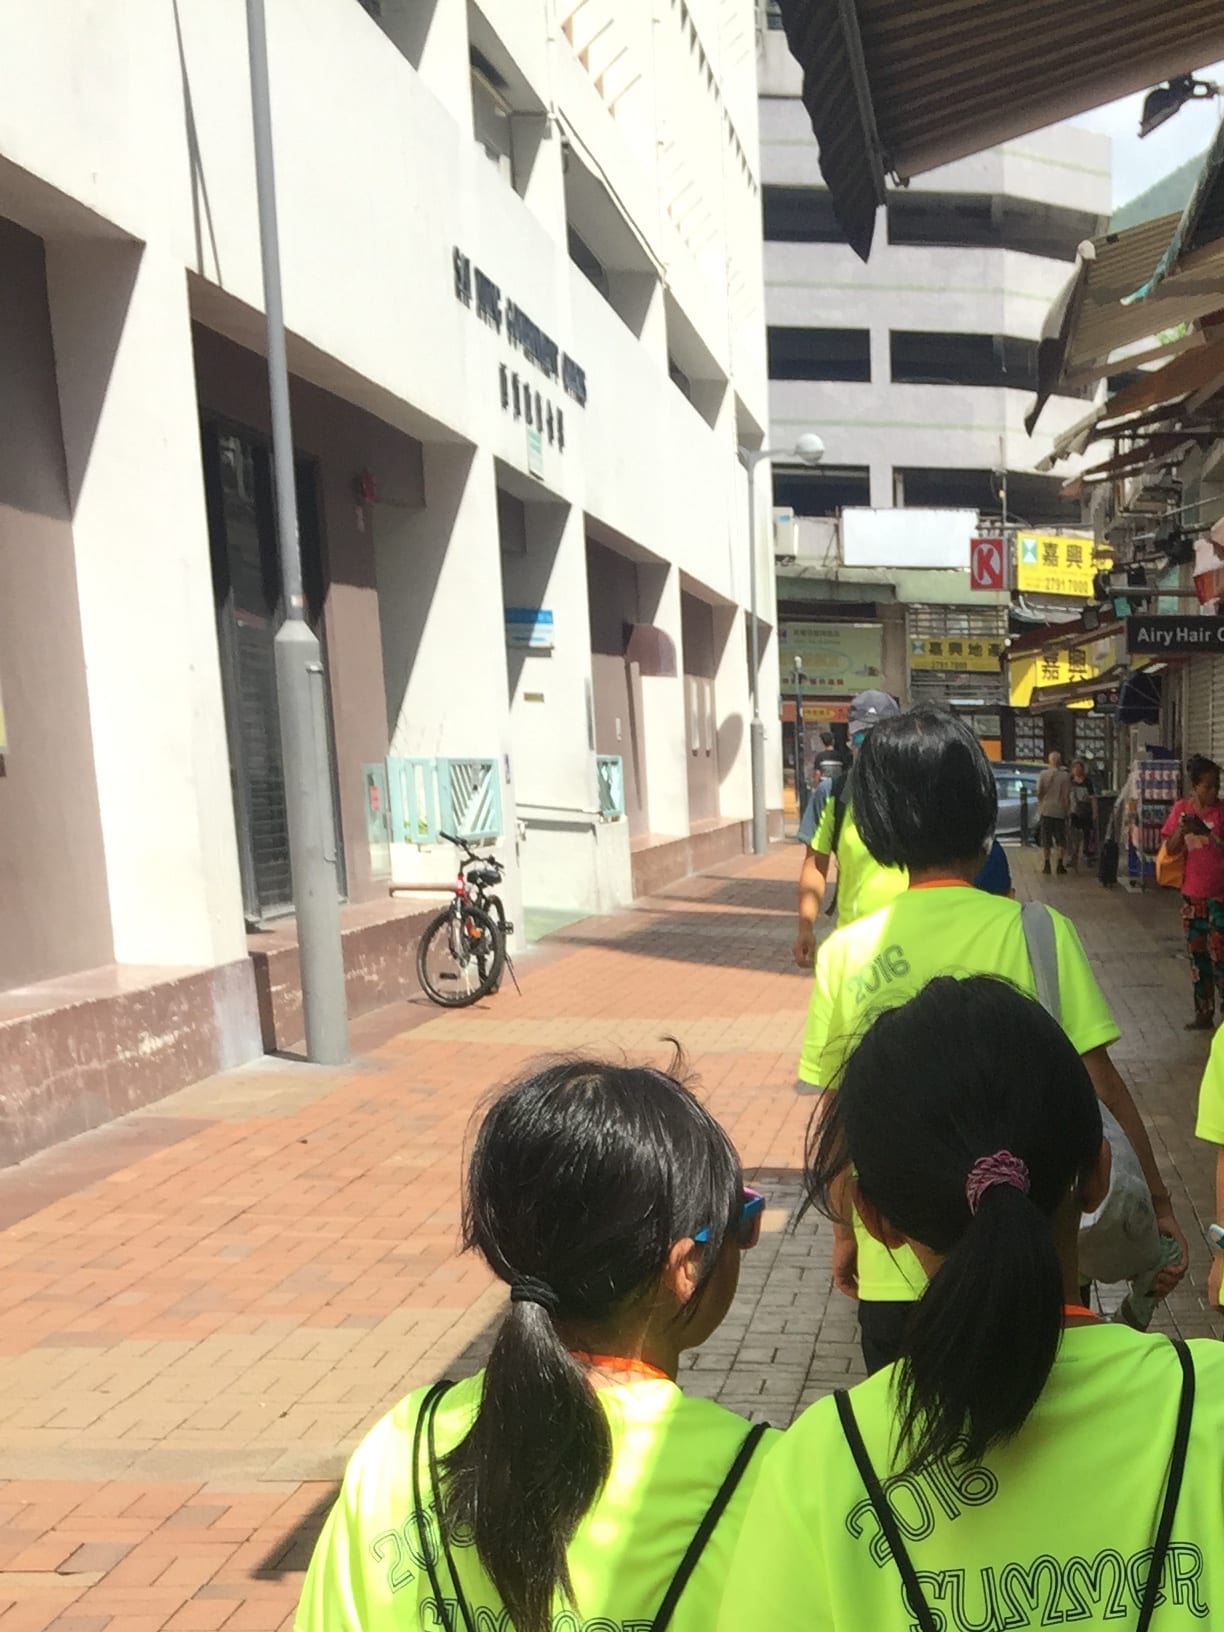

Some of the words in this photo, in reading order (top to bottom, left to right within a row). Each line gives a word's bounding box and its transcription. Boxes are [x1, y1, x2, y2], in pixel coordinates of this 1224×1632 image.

[1137, 627, 1173, 646] Airy
[1176, 627, 1211, 642] Hair
[846, 1433, 999, 1568] 2016
